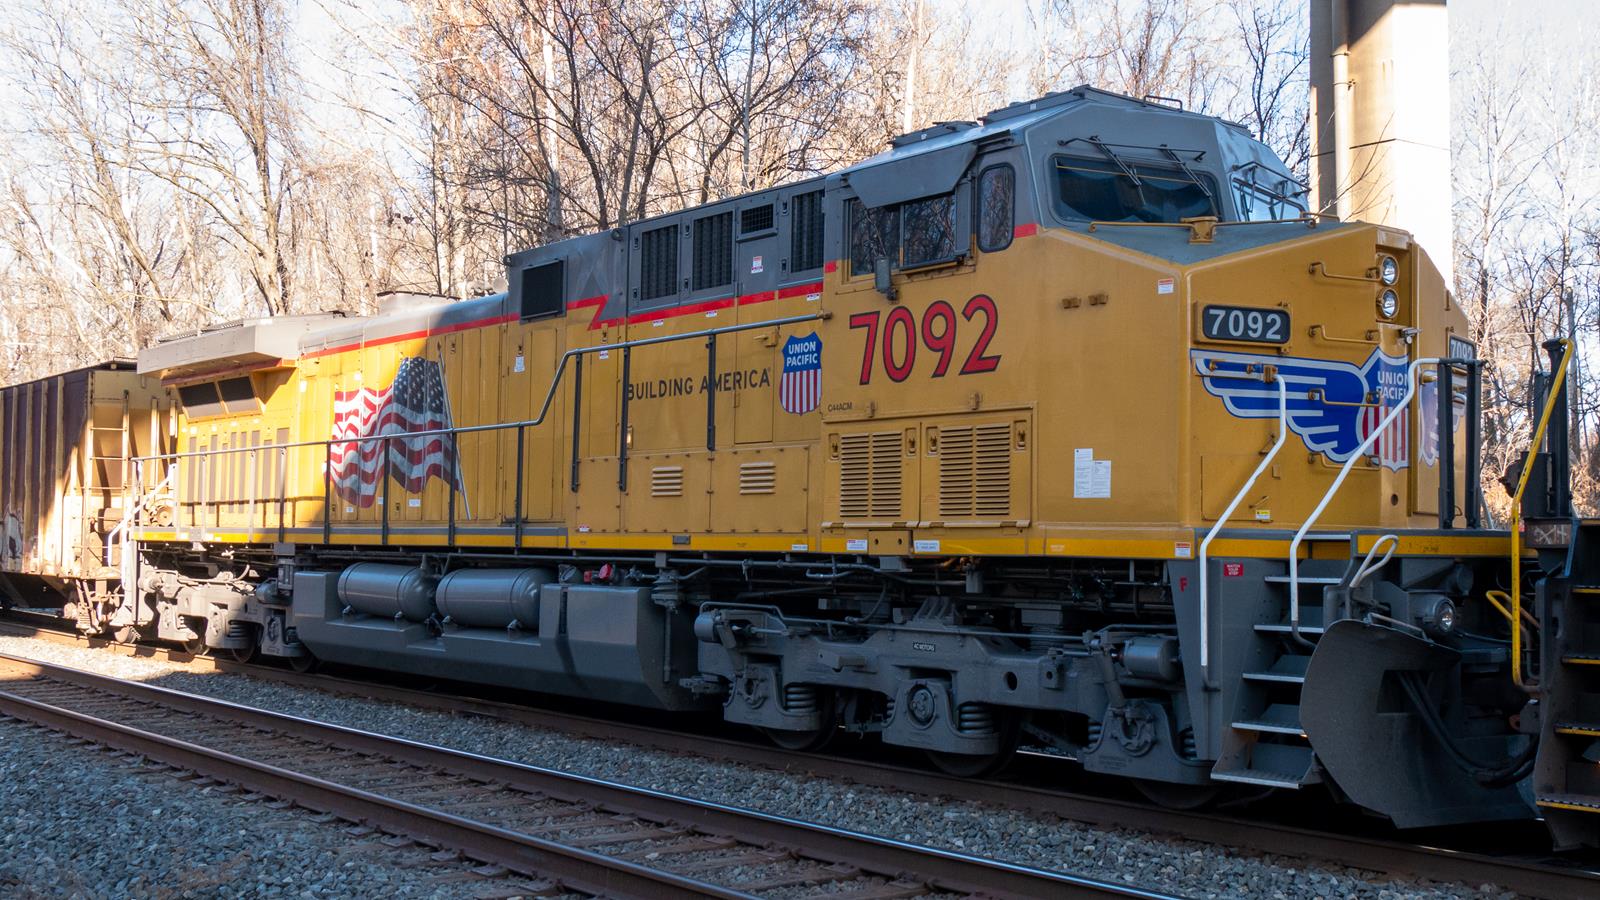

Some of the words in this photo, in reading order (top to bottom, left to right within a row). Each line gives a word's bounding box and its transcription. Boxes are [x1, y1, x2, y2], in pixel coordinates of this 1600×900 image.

[849, 294, 1002, 385] 7092
[1209, 308, 1282, 340] 7092
[786, 353, 818, 367] PACIFIC
[788, 341, 816, 355] UNION
[628, 377, 693, 401] BUILDING
[699, 368, 770, 394] AMERICA
